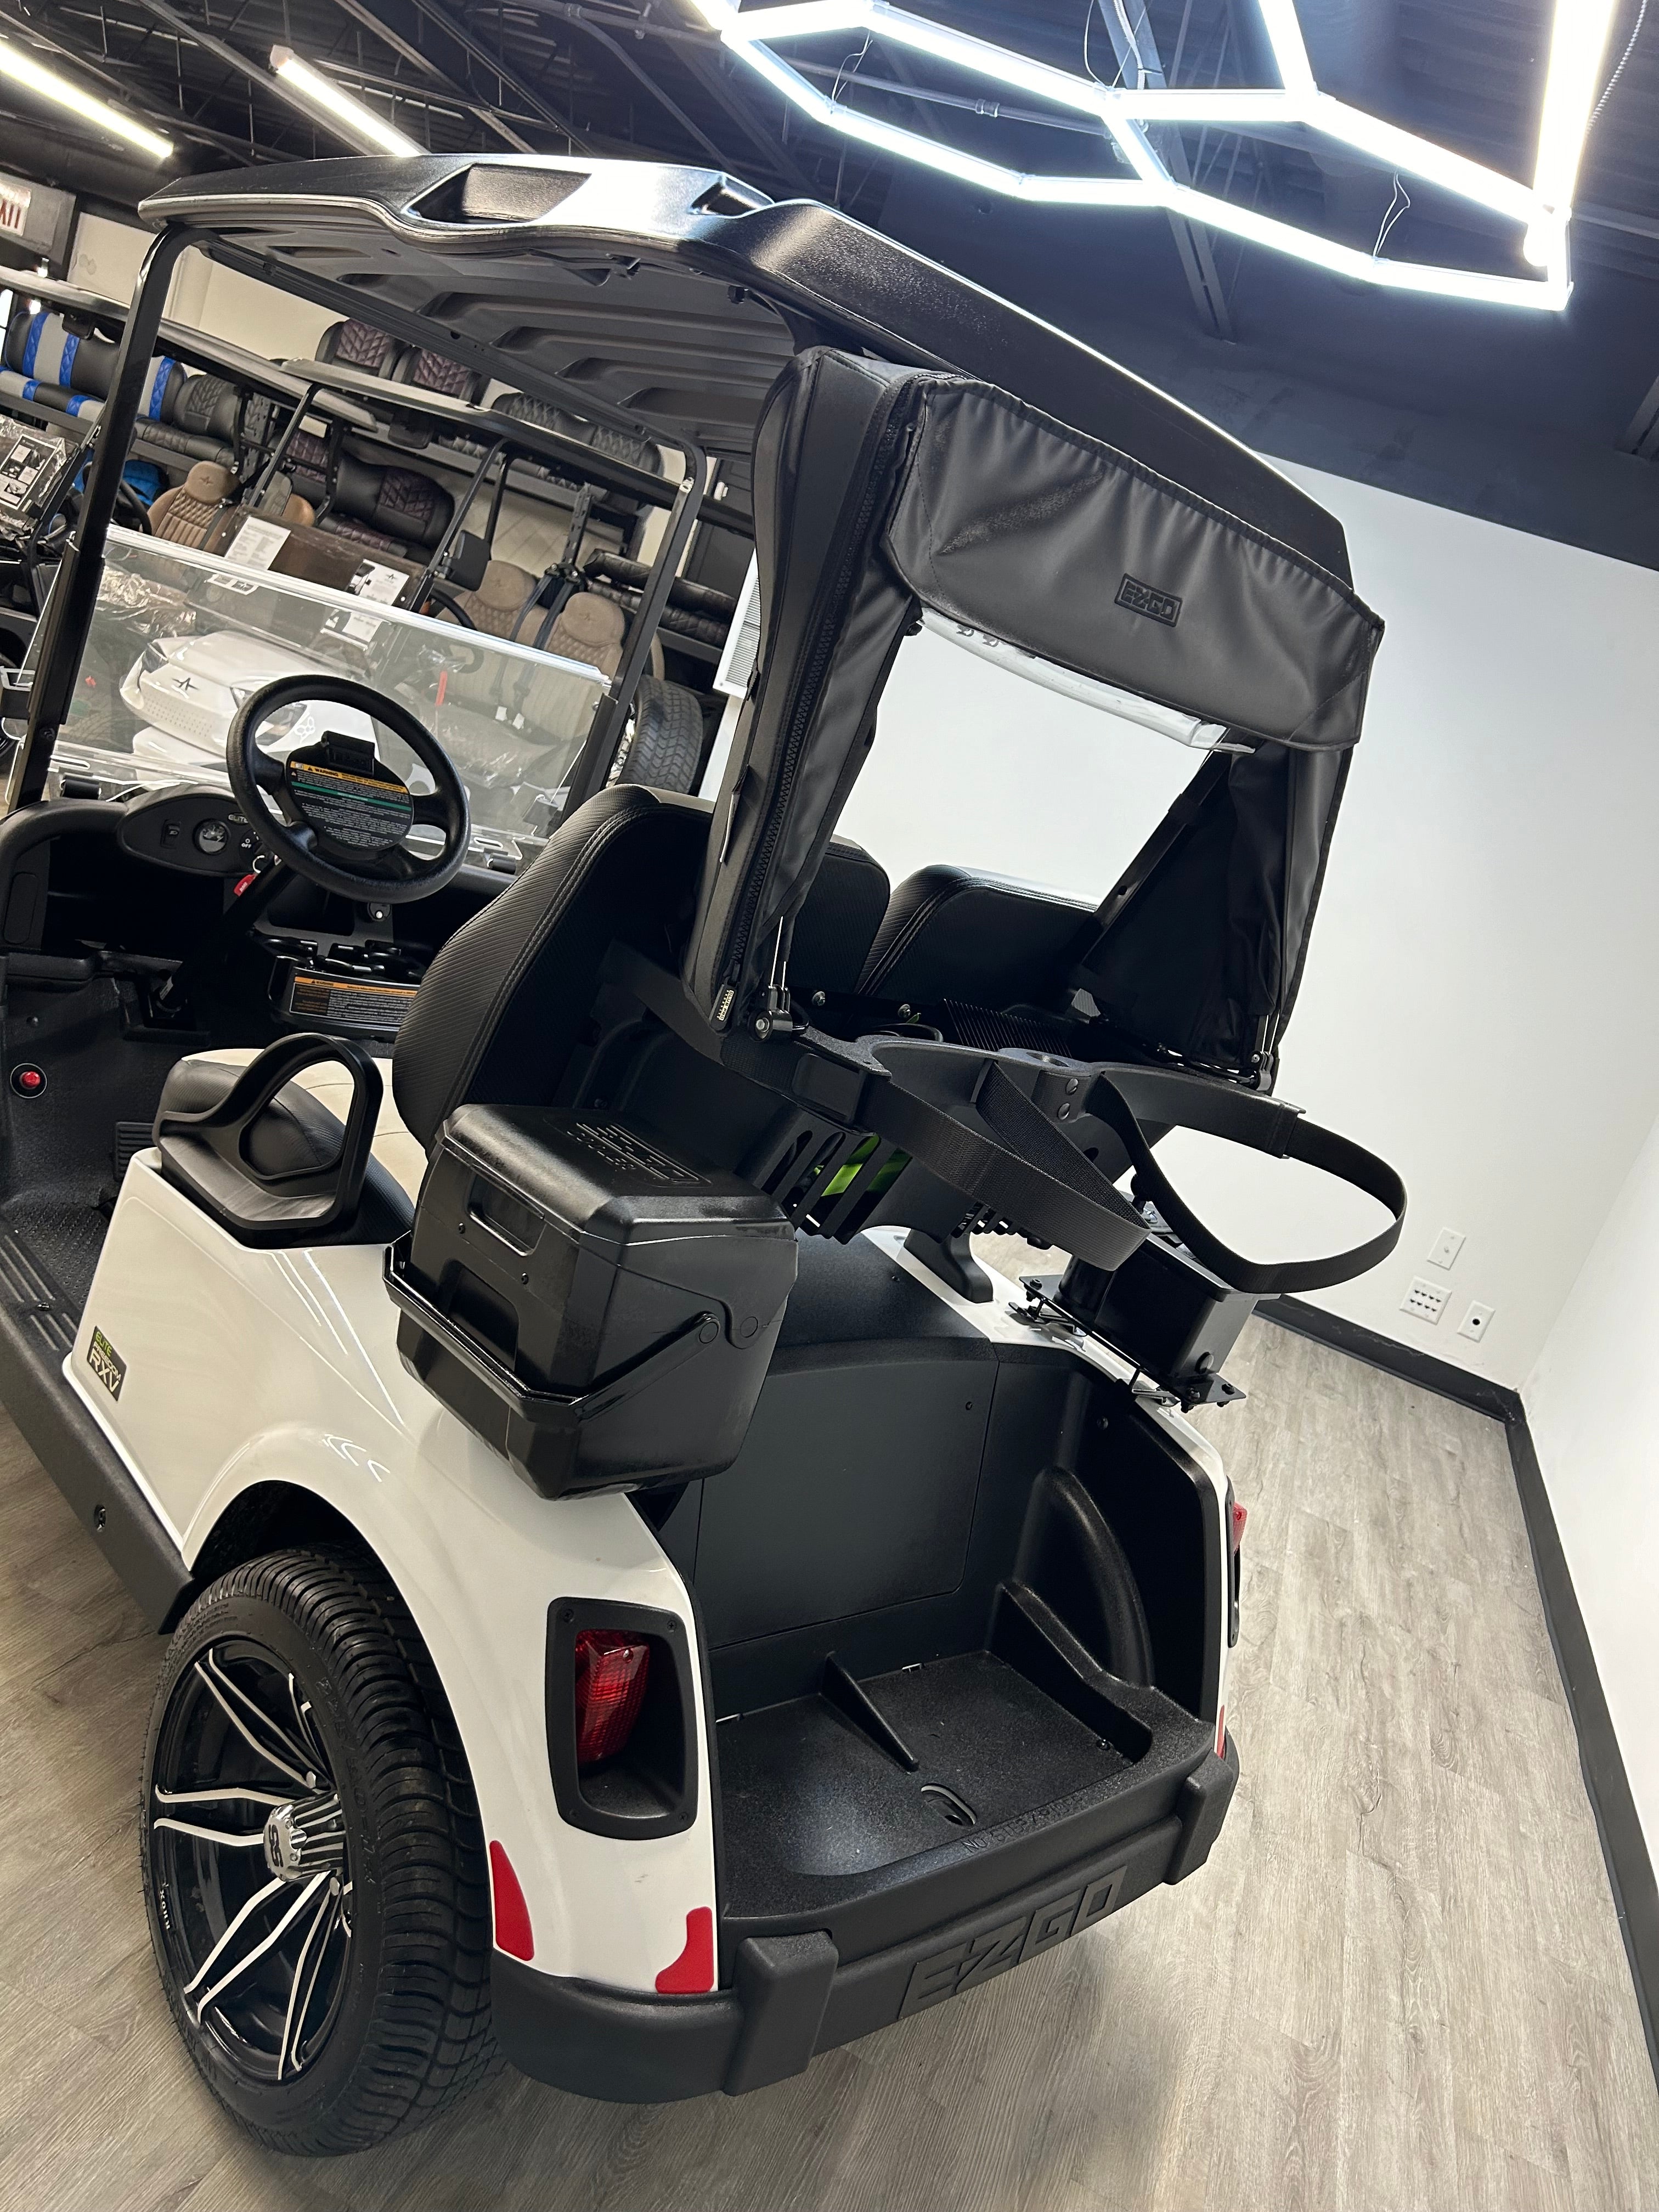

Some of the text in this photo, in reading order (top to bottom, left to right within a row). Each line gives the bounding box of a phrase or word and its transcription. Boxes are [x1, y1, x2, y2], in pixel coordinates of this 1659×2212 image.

[314, 768, 339, 777] WARNING
[93, 1341, 122, 1381] FREEDOM
[95, 1331, 112, 1357] ELITE
[89, 1347, 120, 1392] RXV
[961, 1837, 988, 1853] NO
[989, 1818, 1028, 1842] STEP
[896, 1865, 1128, 2021] EZGO
